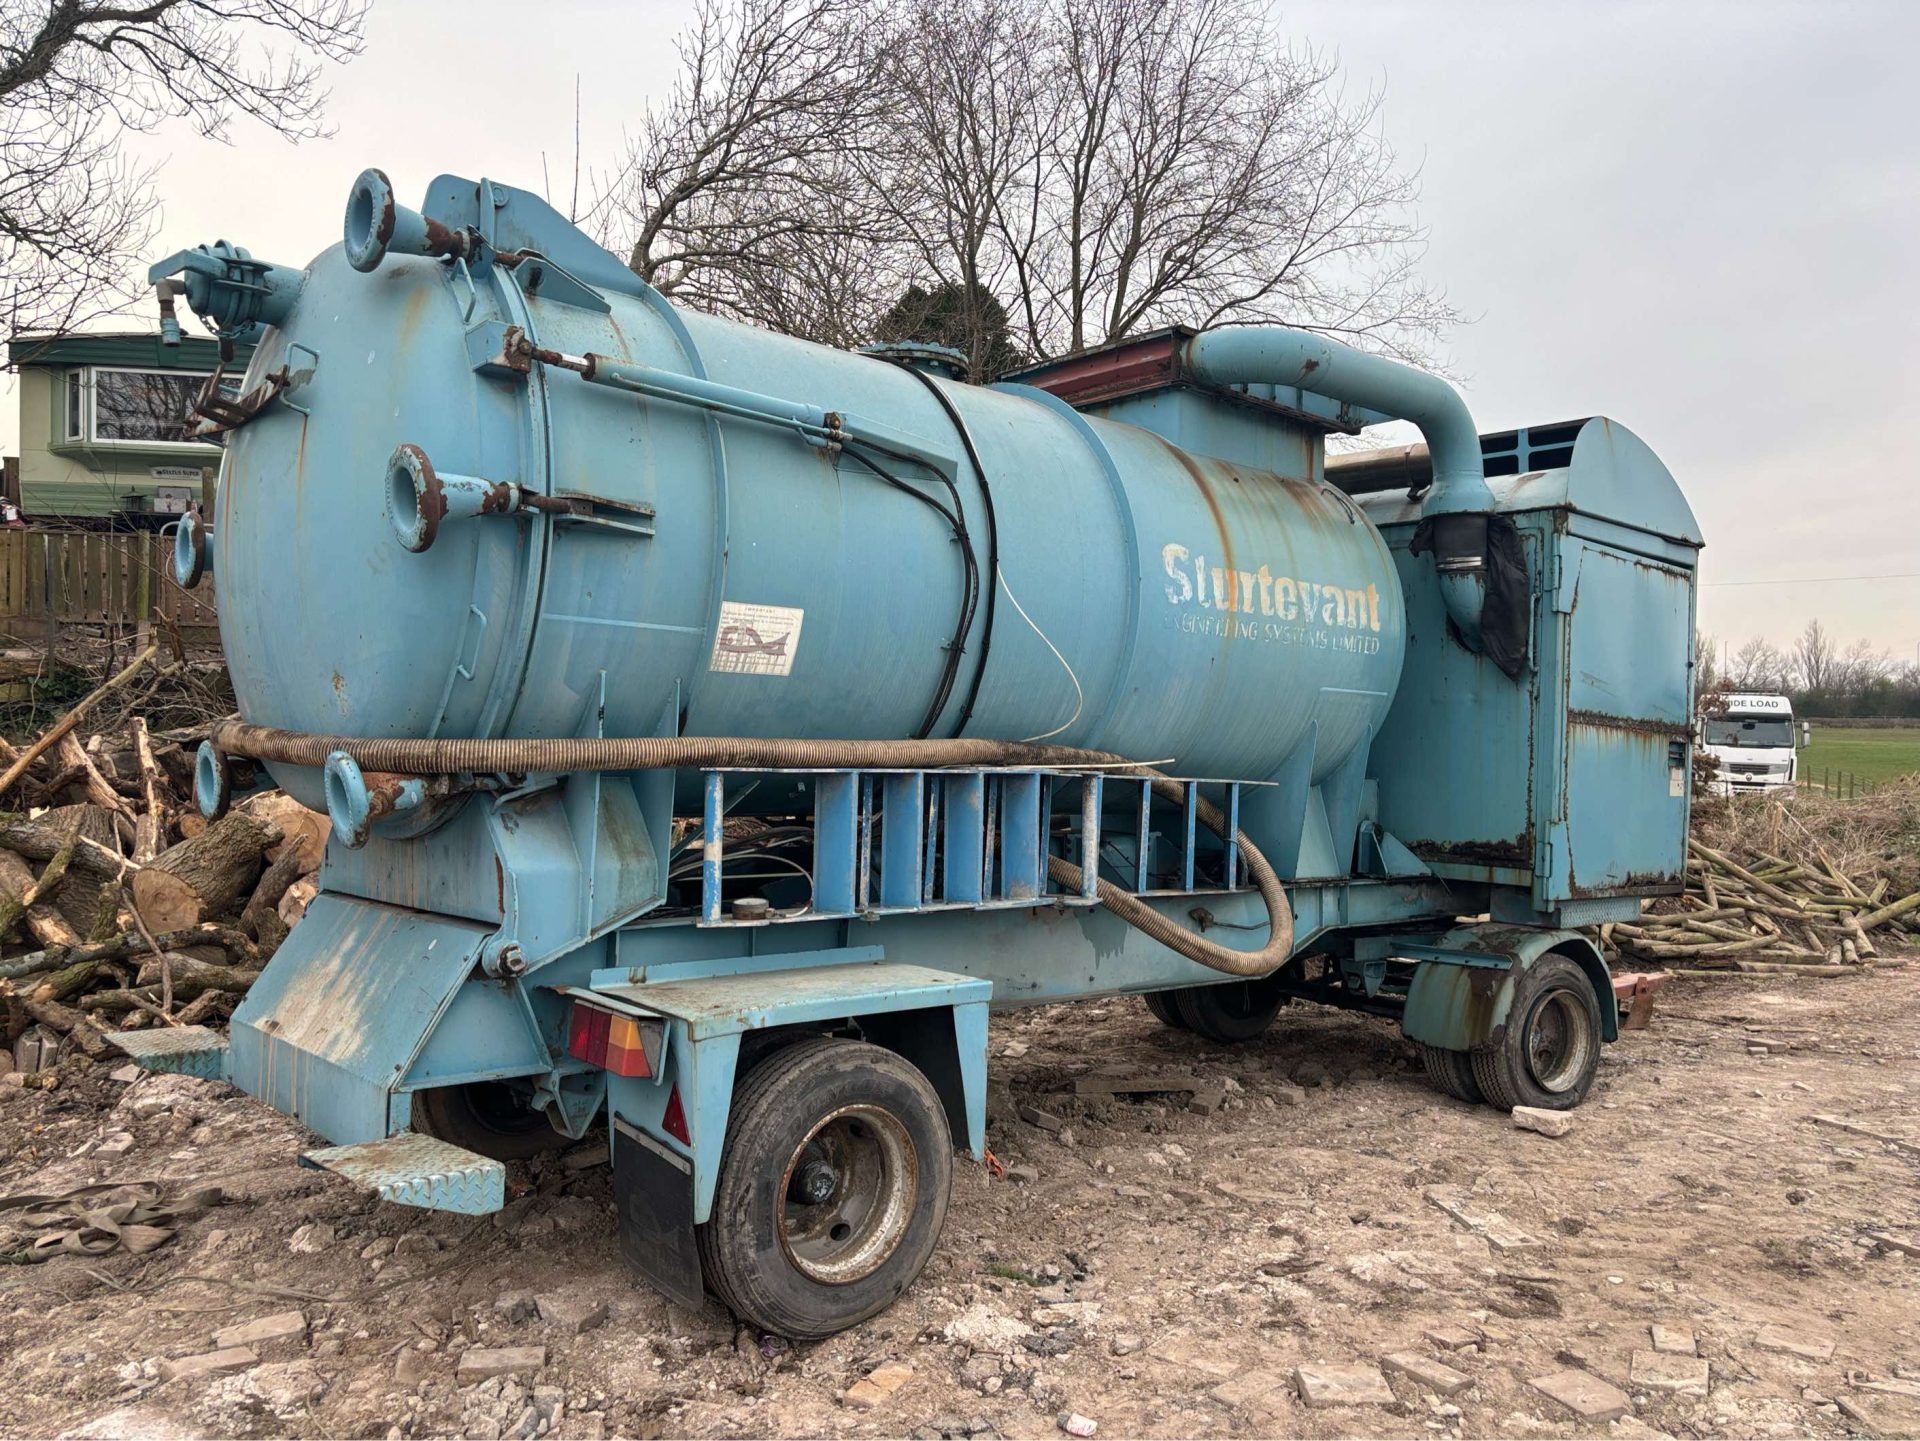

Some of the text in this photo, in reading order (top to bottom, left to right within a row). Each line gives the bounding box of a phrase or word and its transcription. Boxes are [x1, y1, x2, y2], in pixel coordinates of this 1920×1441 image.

[1162, 543, 1381, 632] Sturtevant
[1164, 612, 1257, 640] NGINEEING
[1332, 635, 1380, 655] LIMITED
